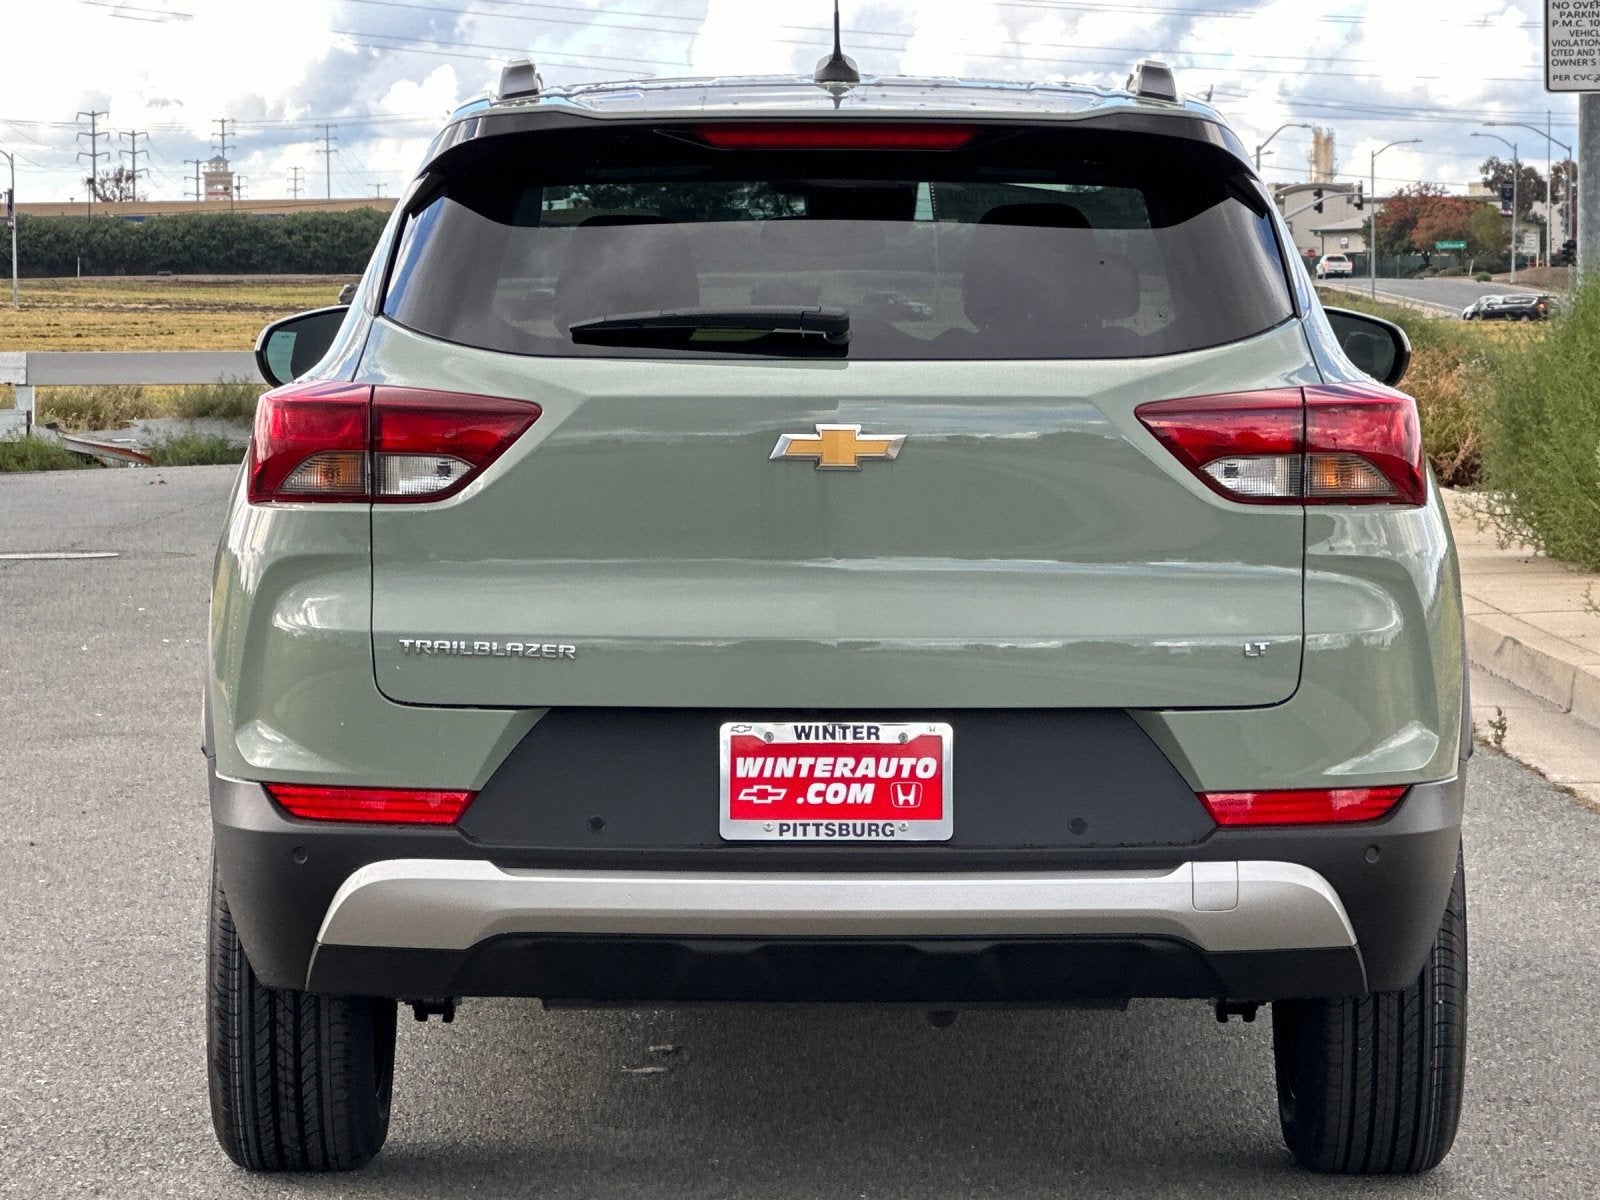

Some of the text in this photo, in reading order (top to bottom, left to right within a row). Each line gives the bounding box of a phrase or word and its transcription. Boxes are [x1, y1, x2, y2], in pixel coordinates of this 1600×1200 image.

[1552, 2, 1570, 10] NO
[1551, 48, 1574, 57] CITED
[1576, 48, 1595, 57] AND
[1551, 58, 1597, 67] OWNER'S
[1573, 73, 1592, 81] CVC
[398, 639, 576, 660] TRAILBLAZER
[1244, 642, 1270, 657] LT
[793, 725, 880, 741] WINTER
[735, 756, 938, 779] WINTERAUTO
[795, 782, 876, 805] .COM
[778, 822, 896, 838] PITTSBURG
